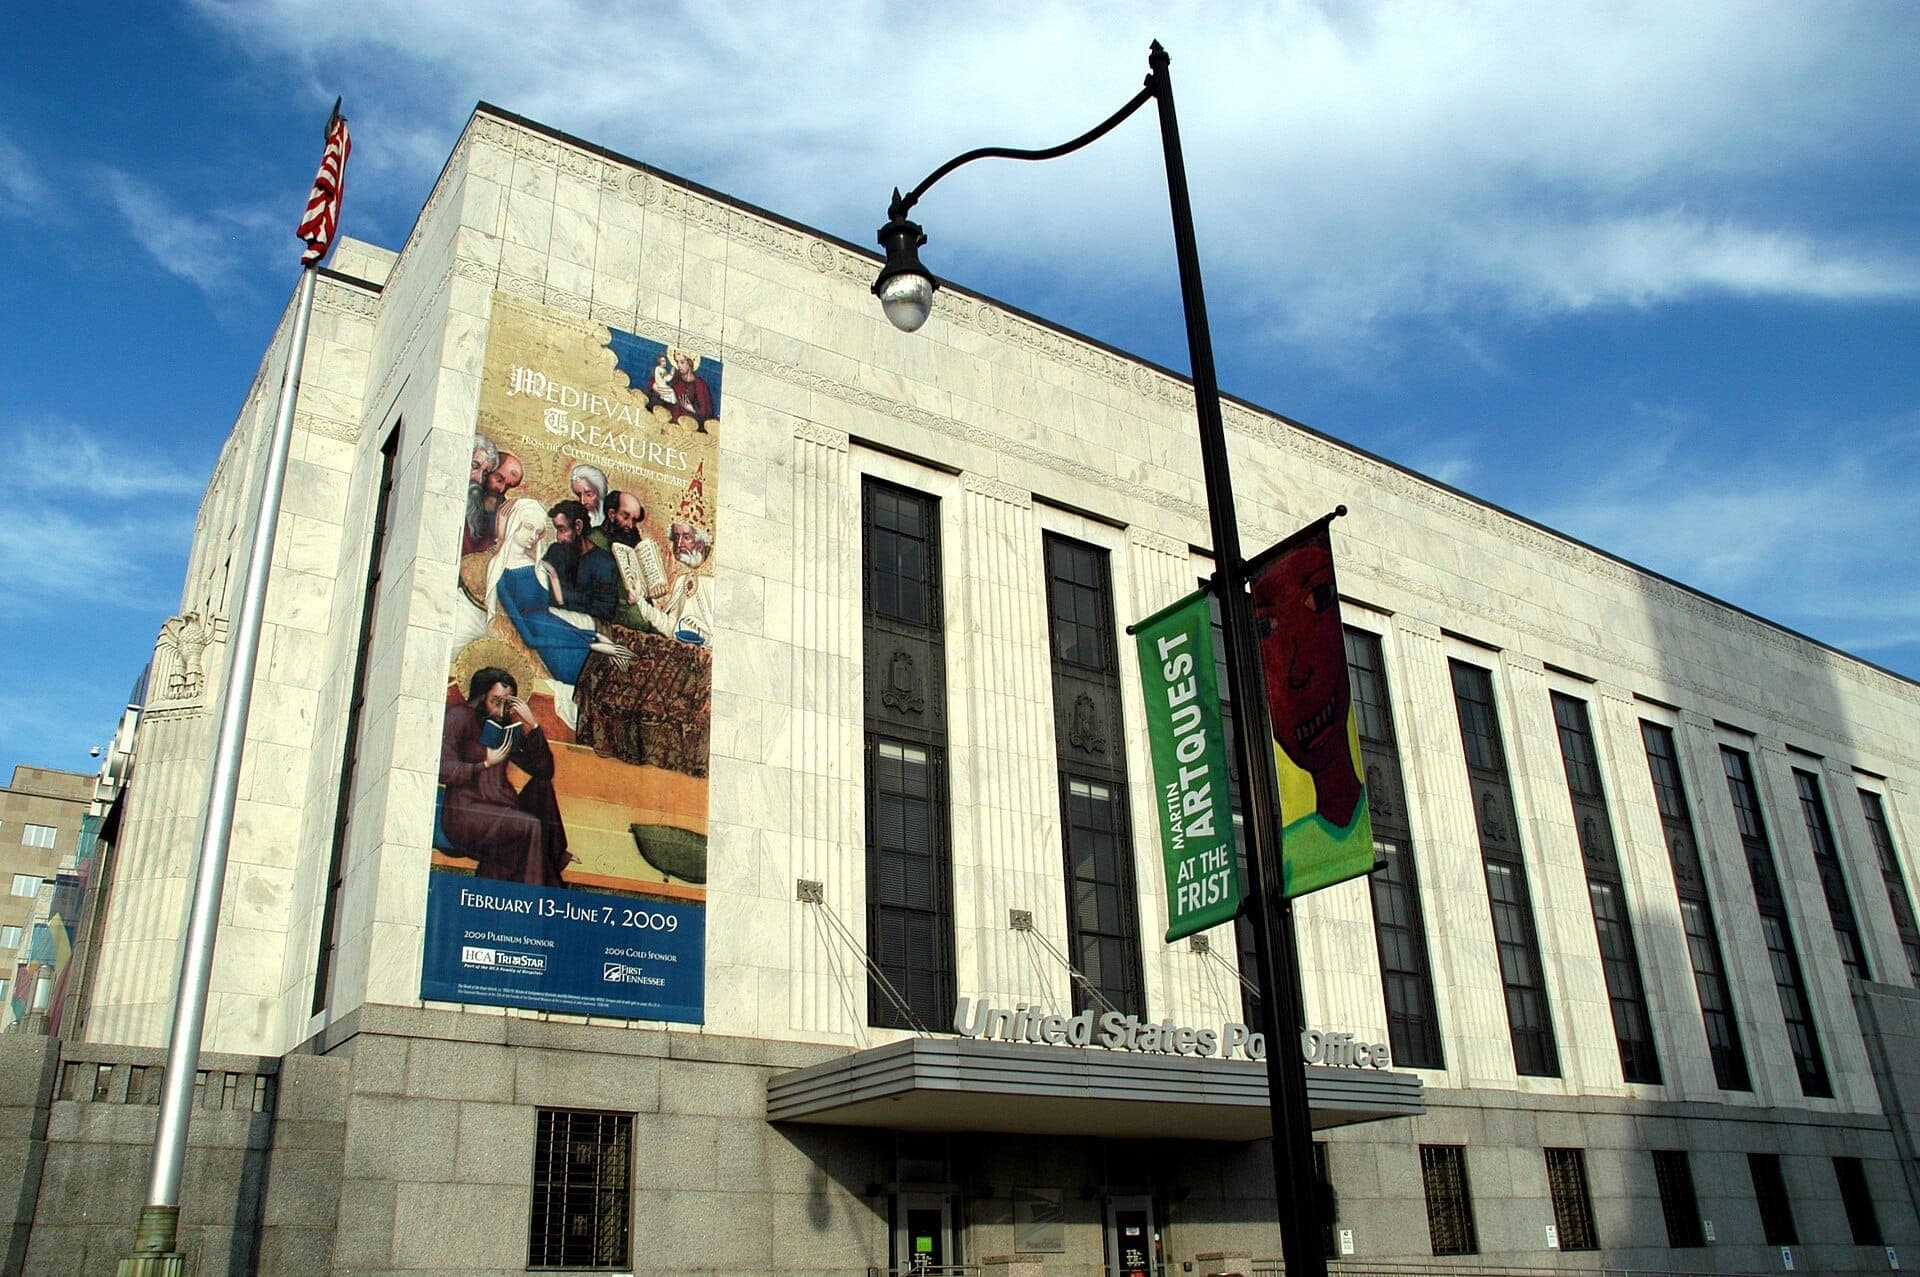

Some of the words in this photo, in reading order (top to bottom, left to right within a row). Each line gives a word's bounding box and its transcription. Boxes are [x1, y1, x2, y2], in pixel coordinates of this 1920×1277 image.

[1157, 632, 1216, 838] ARTQUEST
[1165, 781, 1185, 850] MARTIN
[1177, 856, 1196, 884] AT
[1199, 843, 1229, 874] THE
[460, 888, 533, 914] FEBRUARY
[602, 906, 615, 927] 7,
[622, 909, 678, 932] 2009
[1177, 868, 1231, 917] FRIST
[464, 930, 486, 940] 2009
[465, 949, 492, 962] HCA
[604, 947, 625, 957] 2009
[621, 964, 643, 976] FIRST
[621, 974, 666, 987] TENNESSEE
[953, 996, 1095, 1046] United
[1098, 1010, 1217, 1057] States
[1222, 1023, 1267, 1059] Po
[1300, 1029, 1390, 1068] Office
